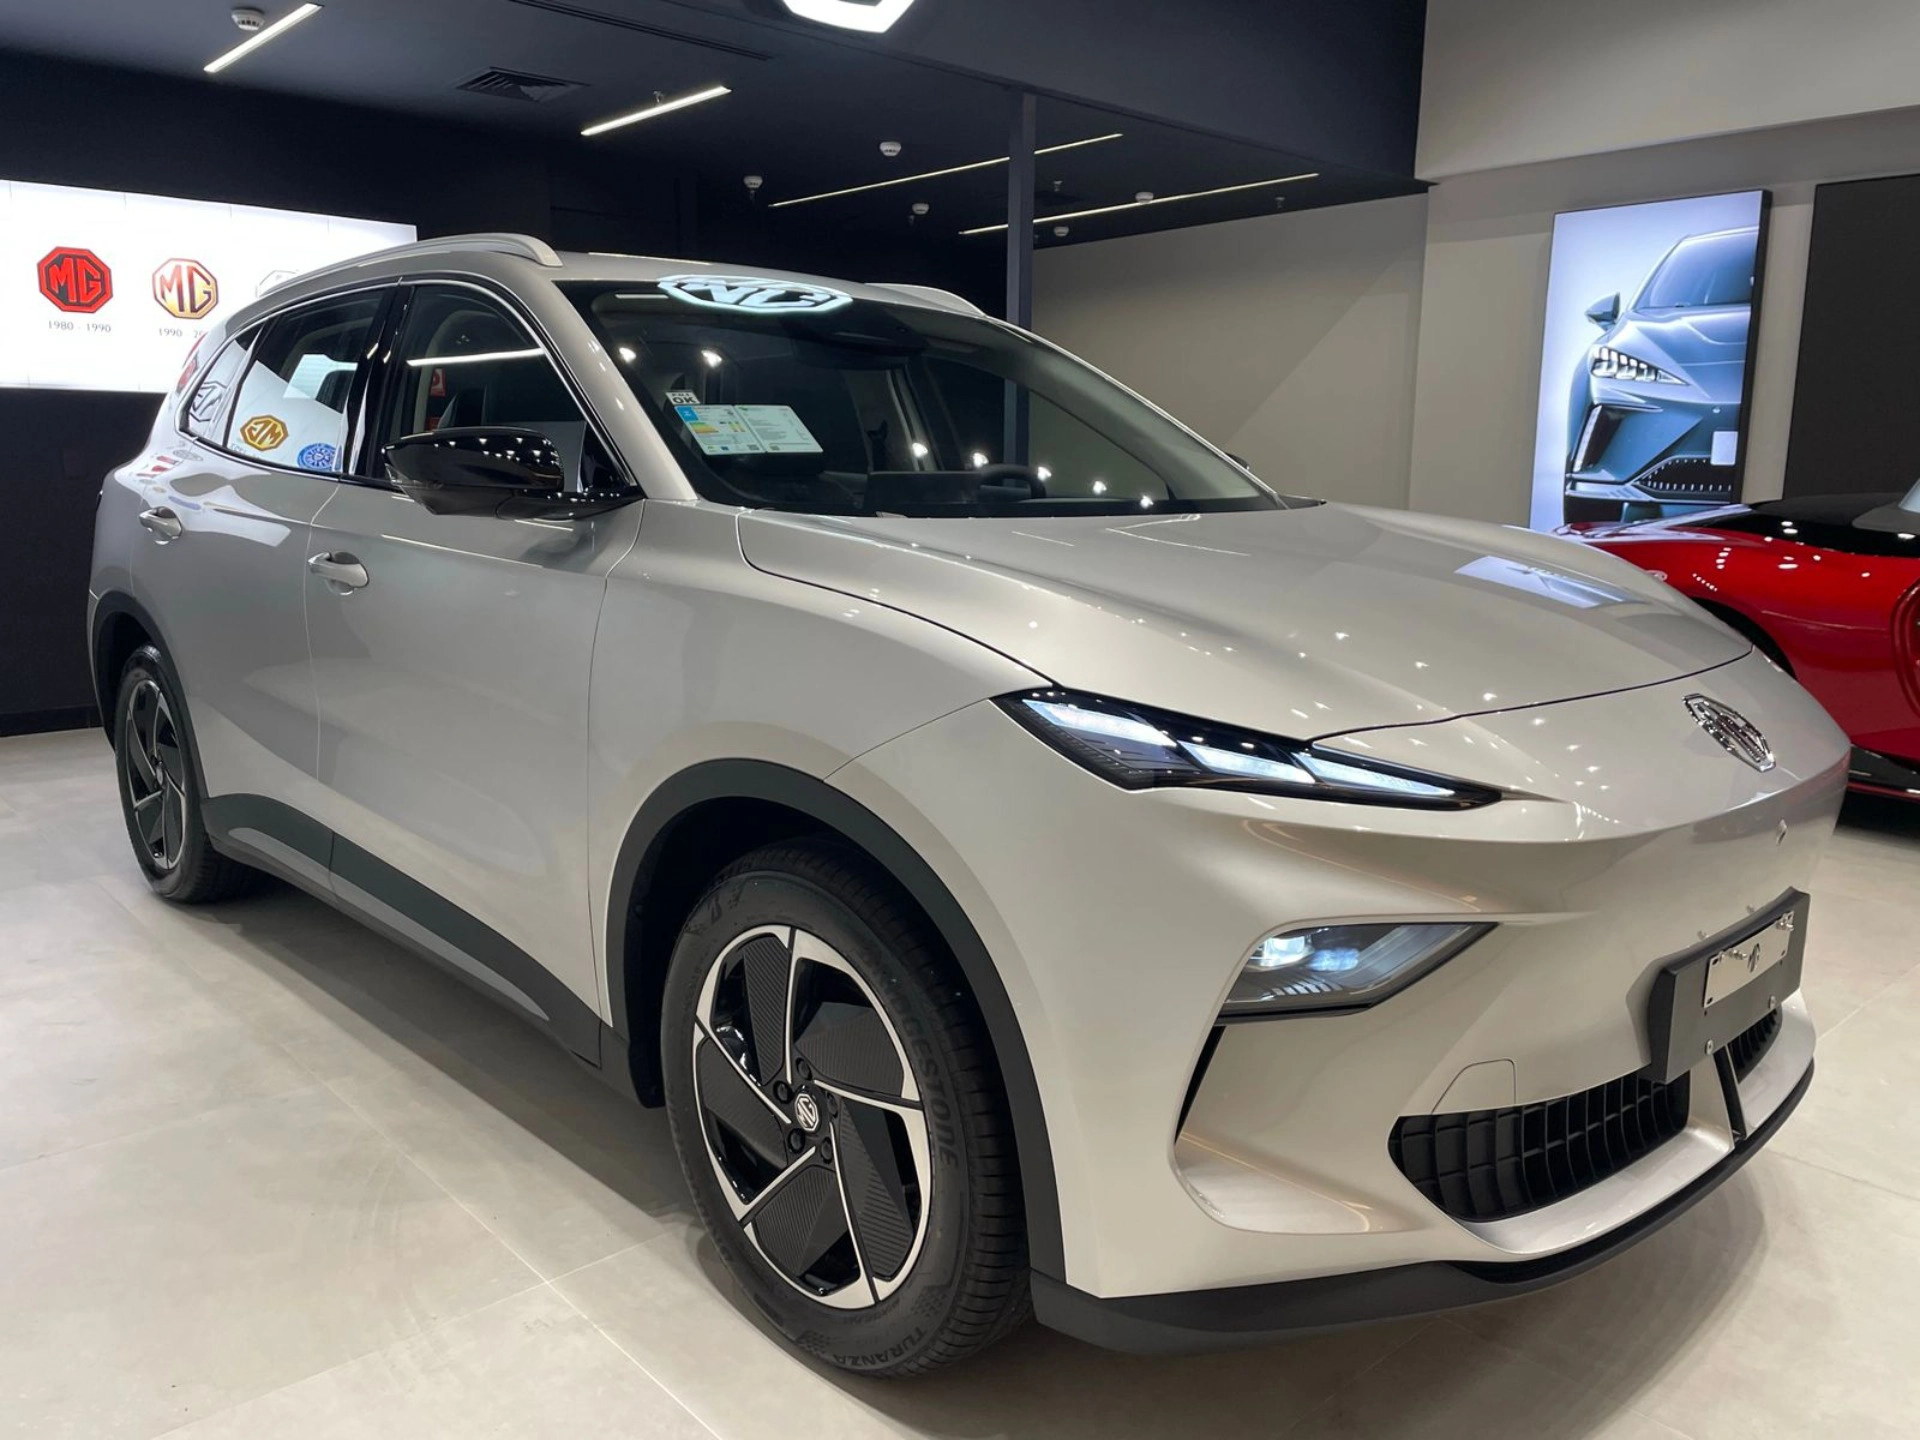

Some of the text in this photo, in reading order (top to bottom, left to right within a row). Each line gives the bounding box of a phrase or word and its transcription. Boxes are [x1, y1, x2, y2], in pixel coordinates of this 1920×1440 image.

[47, 255, 103, 304] MG
[158, 263, 213, 314] MG
[48, 319, 74, 331] 1980
[86, 322, 112, 333] 1990
[158, 327, 183, 338] 1990
[672, 396, 697, 404] OK
[832, 1326, 928, 1367] TURANZA
